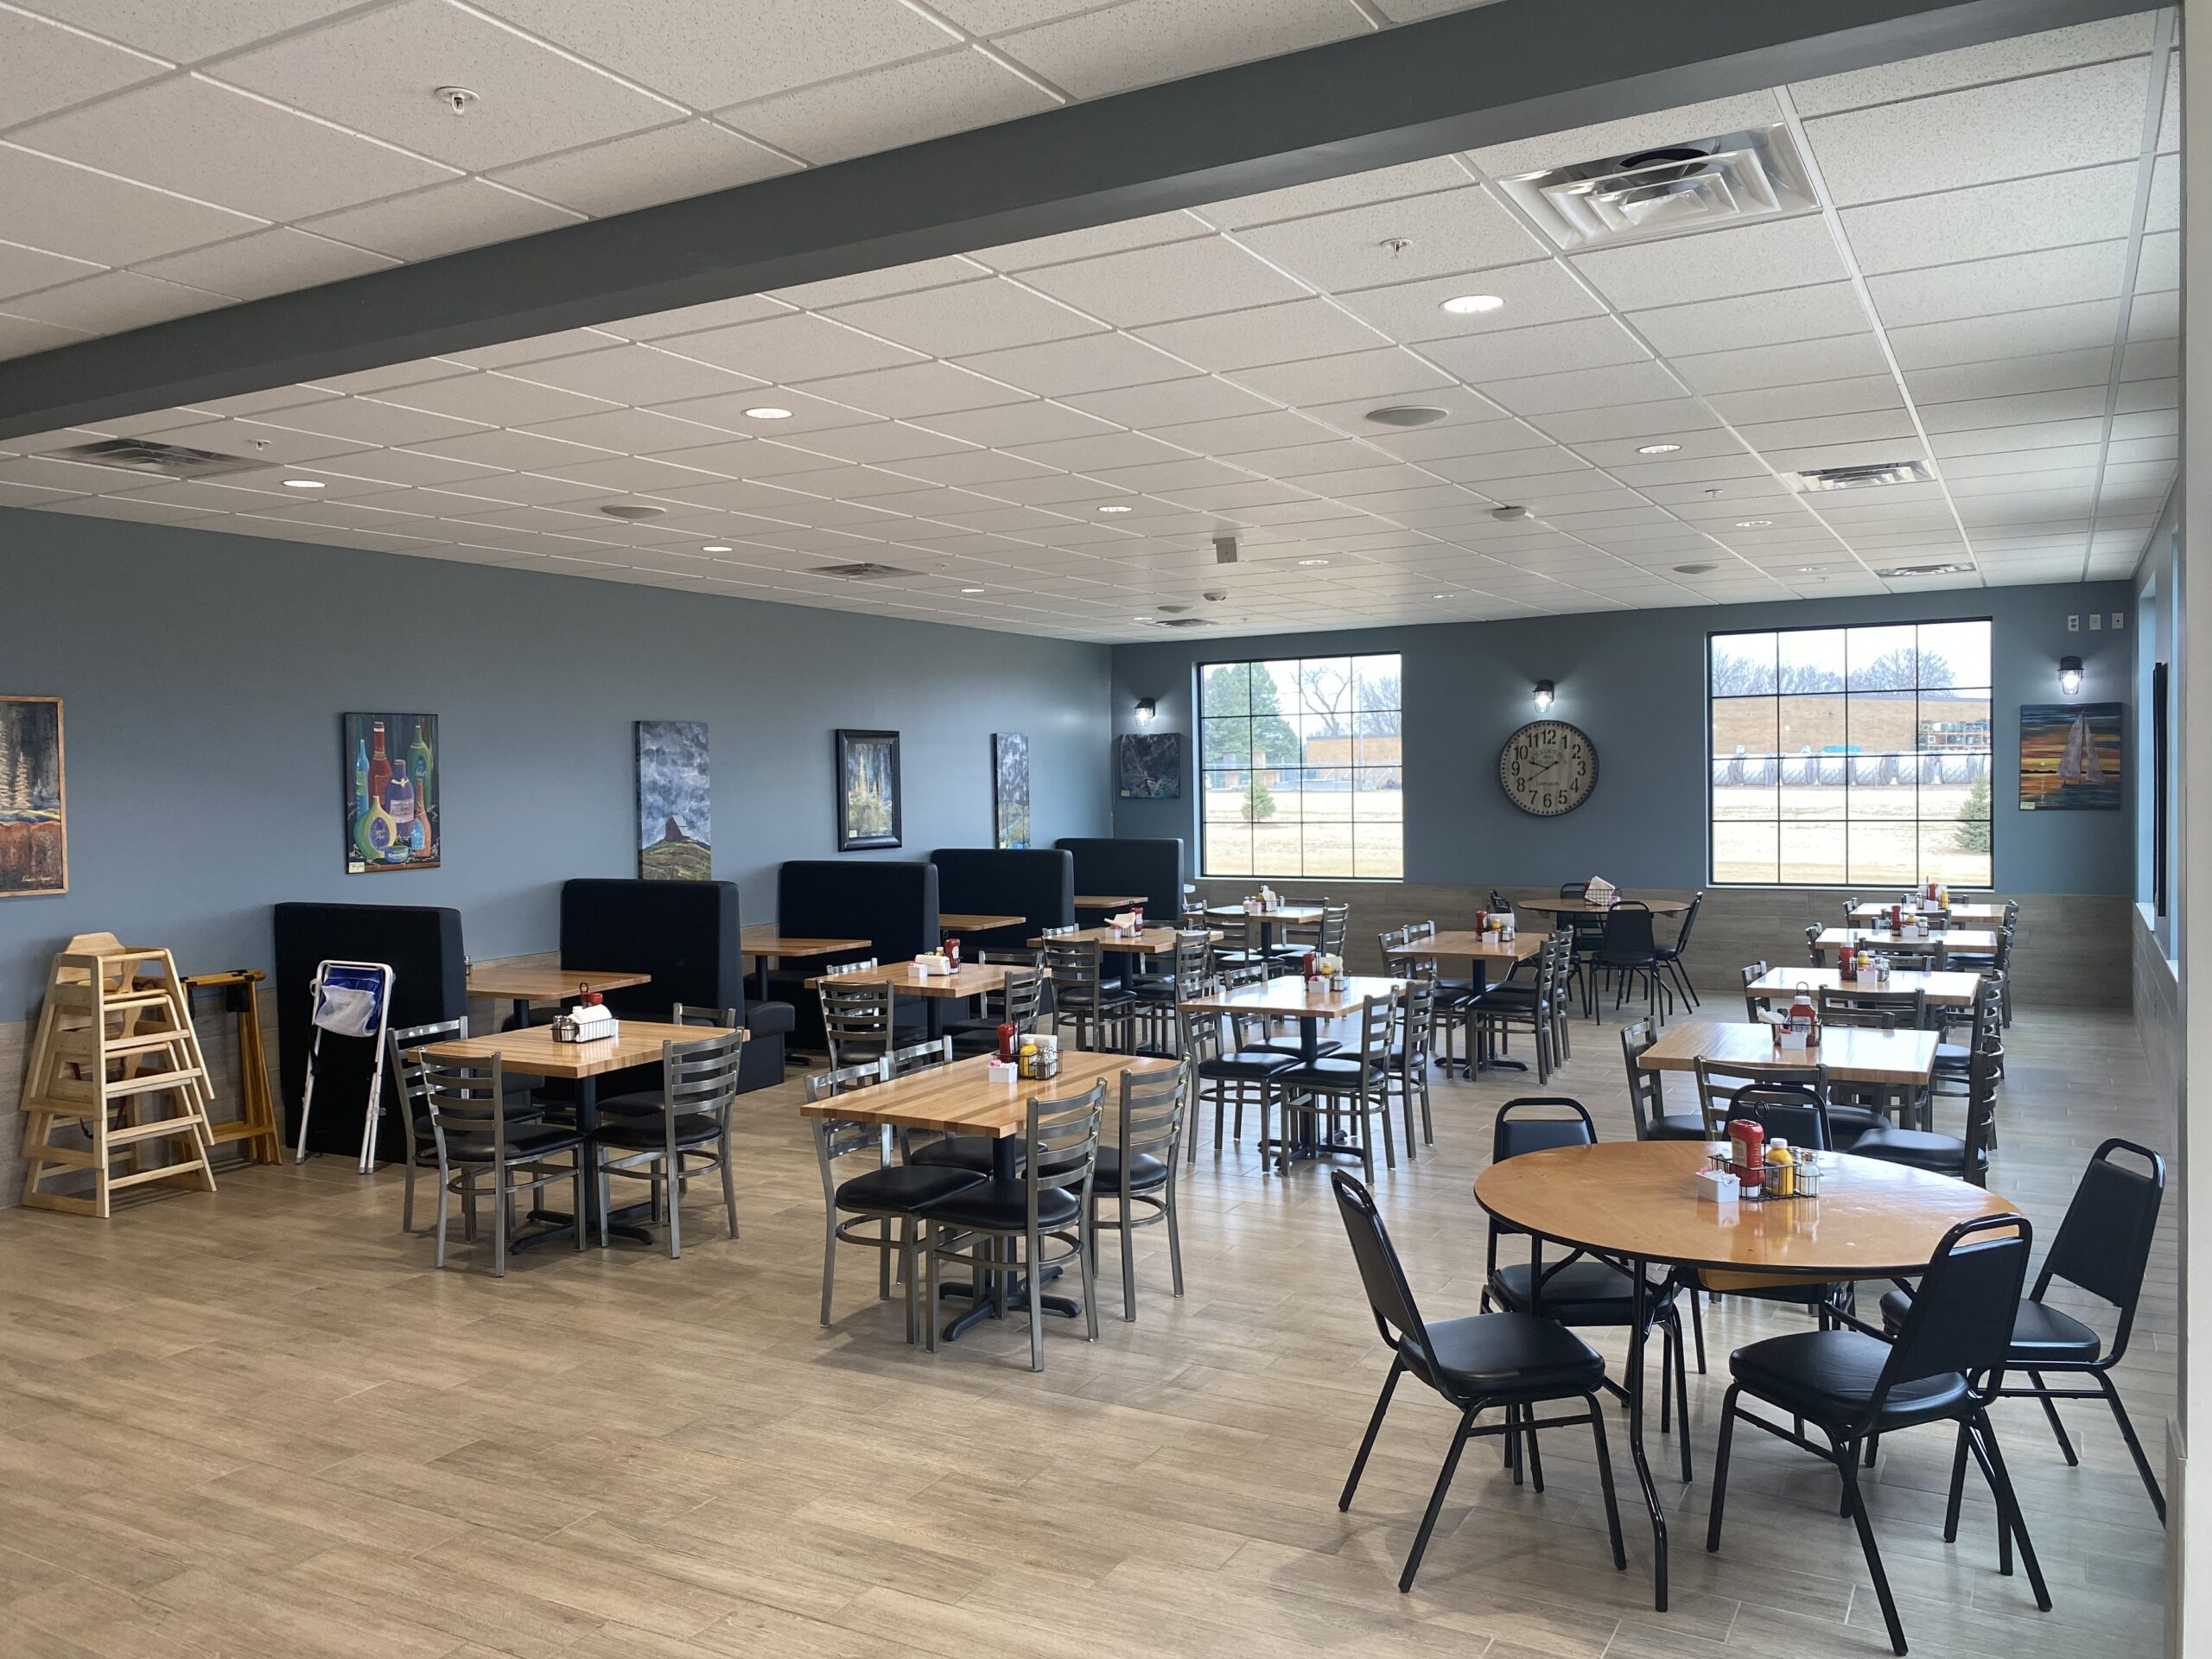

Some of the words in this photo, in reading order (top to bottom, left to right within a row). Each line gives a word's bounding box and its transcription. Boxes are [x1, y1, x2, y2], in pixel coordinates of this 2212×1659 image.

[1527, 733, 1539, 748] 11
[1541, 729, 1556, 745] 12
[1562, 734, 1567, 749] 1
[1514, 745, 1529, 760] 10
[1572, 744, 1581, 760] 2
[1511, 761, 1520, 776] 9
[1577, 761, 1586, 776] 3
[1516, 777, 1525, 792] 8
[1570, 778, 1580, 793] 4
[1529, 790, 1538, 804] 7
[1542, 793, 1552, 808] 6
[1559, 790, 1567, 804] 5
